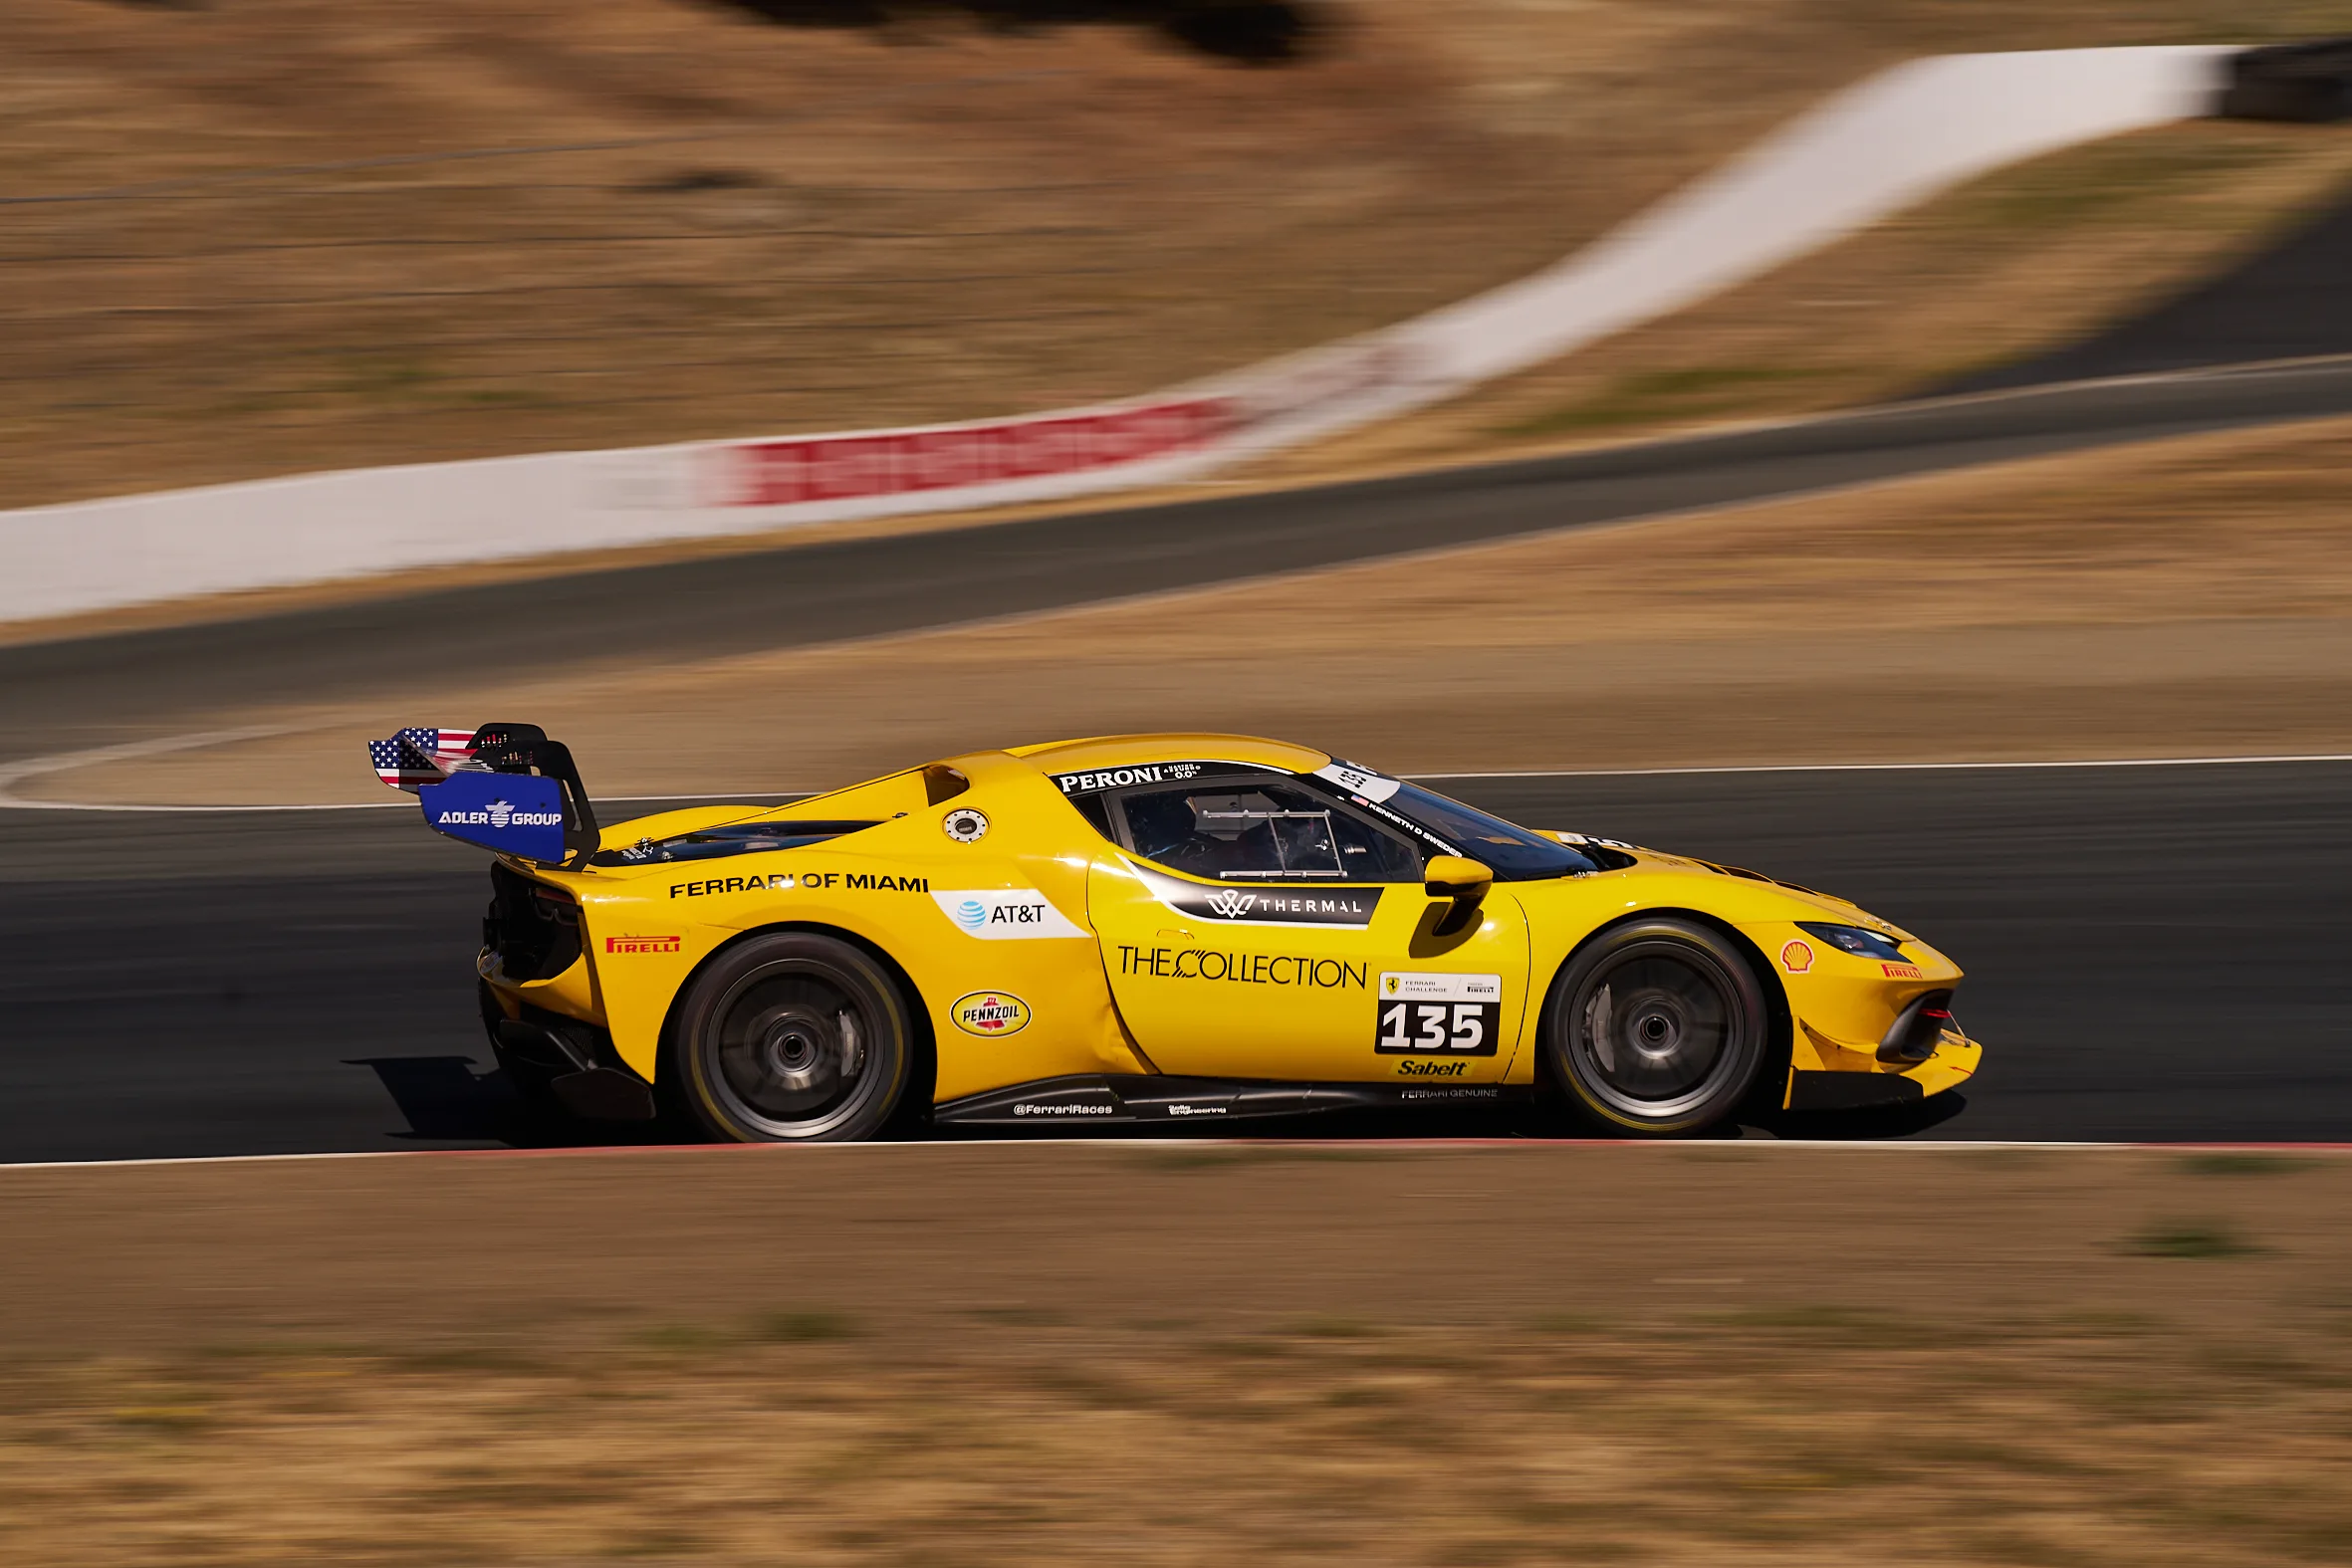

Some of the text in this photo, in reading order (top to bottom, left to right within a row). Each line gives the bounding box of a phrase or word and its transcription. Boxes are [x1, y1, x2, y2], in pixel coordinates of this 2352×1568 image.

[1059, 767, 1163, 792] PERONI
[438, 811, 563, 825] ADLER GROUP
[1369, 802, 1415, 831] KENNETH
[801, 873, 839, 889] OF
[846, 873, 929, 893] MIAMI
[991, 904, 1046, 924] AT&T
[1260, 899, 1362, 913] THERMAL
[605, 936, 681, 954] PIRELLI
[1117, 946, 1367, 990] THE COLLECTION
[1881, 964, 1924, 980] PIRELLI
[963, 1006, 1020, 1022] PENNZOIL
[1381, 1003, 1484, 1049] 135
[1397, 1060, 1468, 1076] Sabelt
[1402, 1089, 1499, 1099] FERRARI GENUINE
[1014, 1104, 1113, 1115] @FerrariRaces
